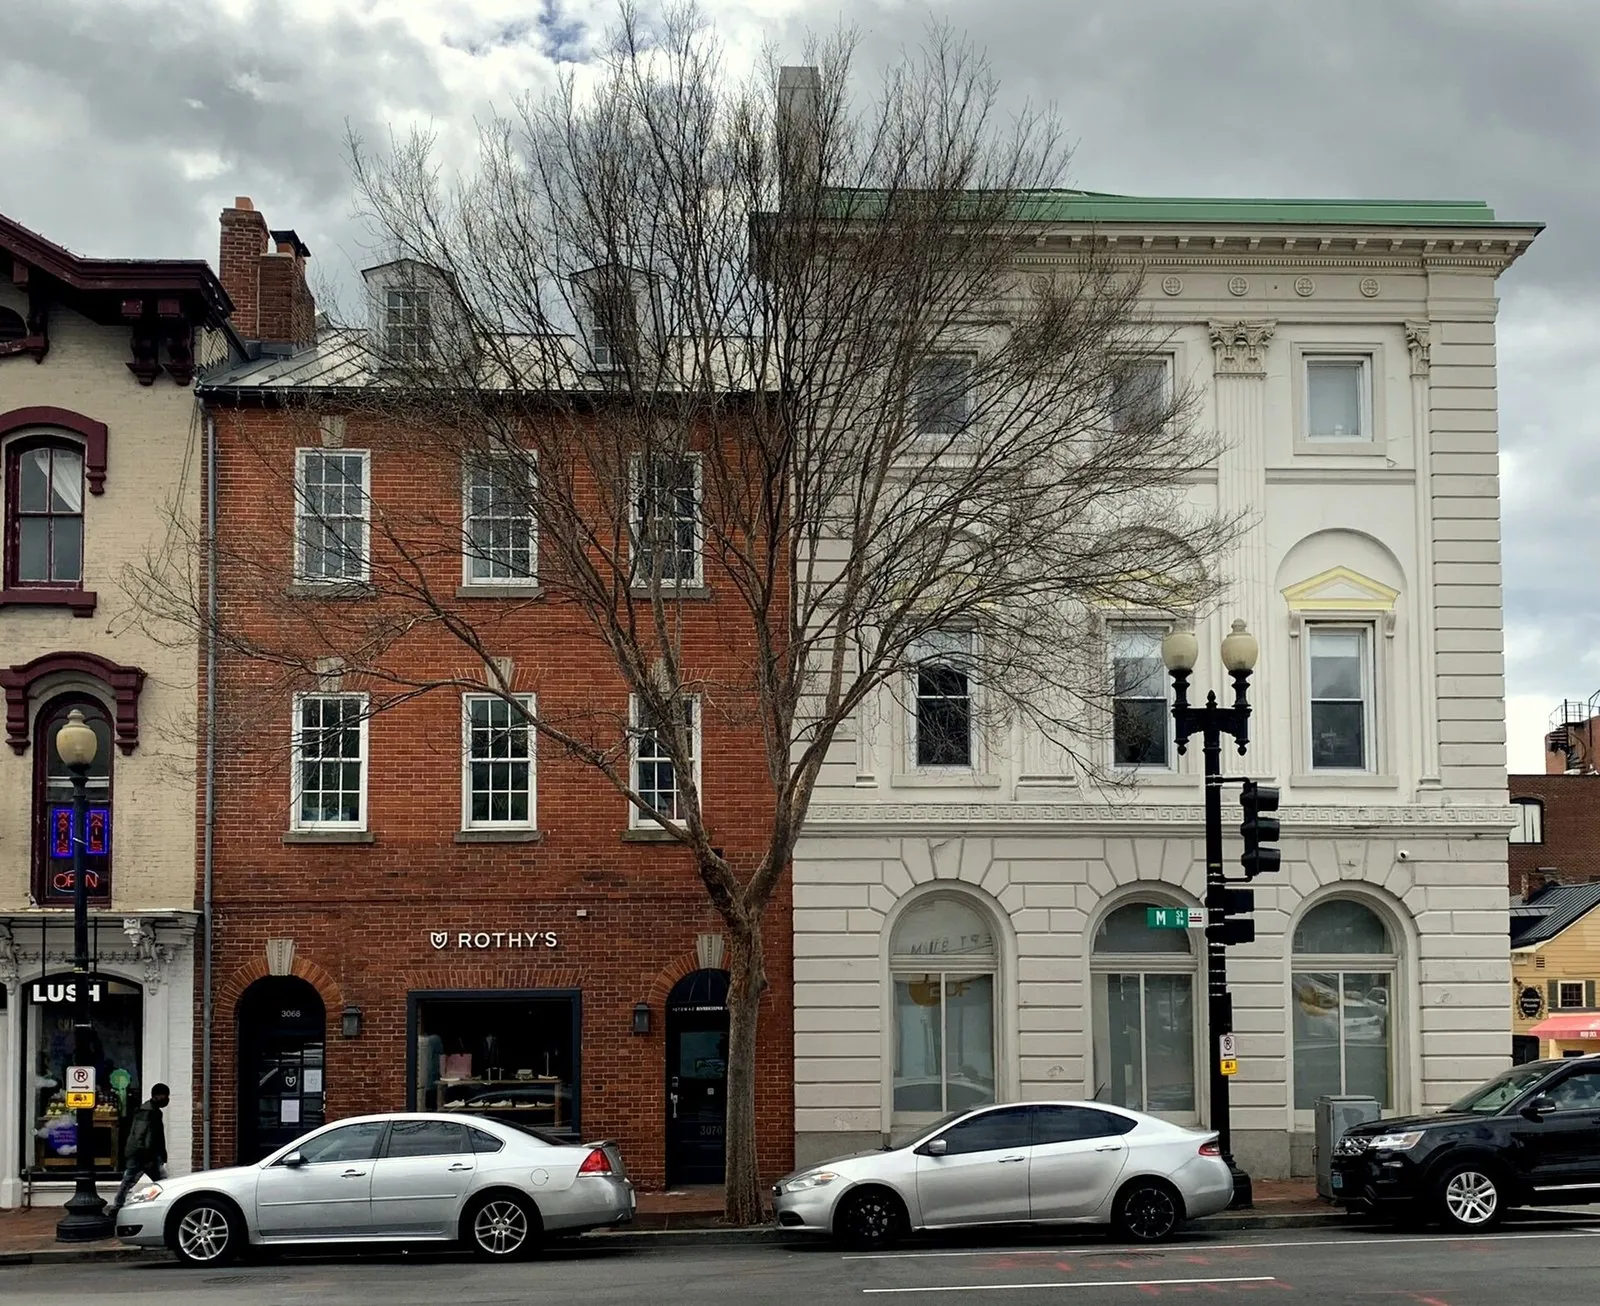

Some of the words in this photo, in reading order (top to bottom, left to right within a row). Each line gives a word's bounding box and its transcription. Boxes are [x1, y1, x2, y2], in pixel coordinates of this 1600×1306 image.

[90, 813, 103, 851] NAILS
[54, 873, 98, 888] OPN
[1156, 910, 1166, 926] M
[458, 931, 557, 948] ROTHY'S
[33, 984, 100, 1002] LUSH
[281, 1010, 301, 1018] 3068
[700, 1125, 722, 1136] 3070
